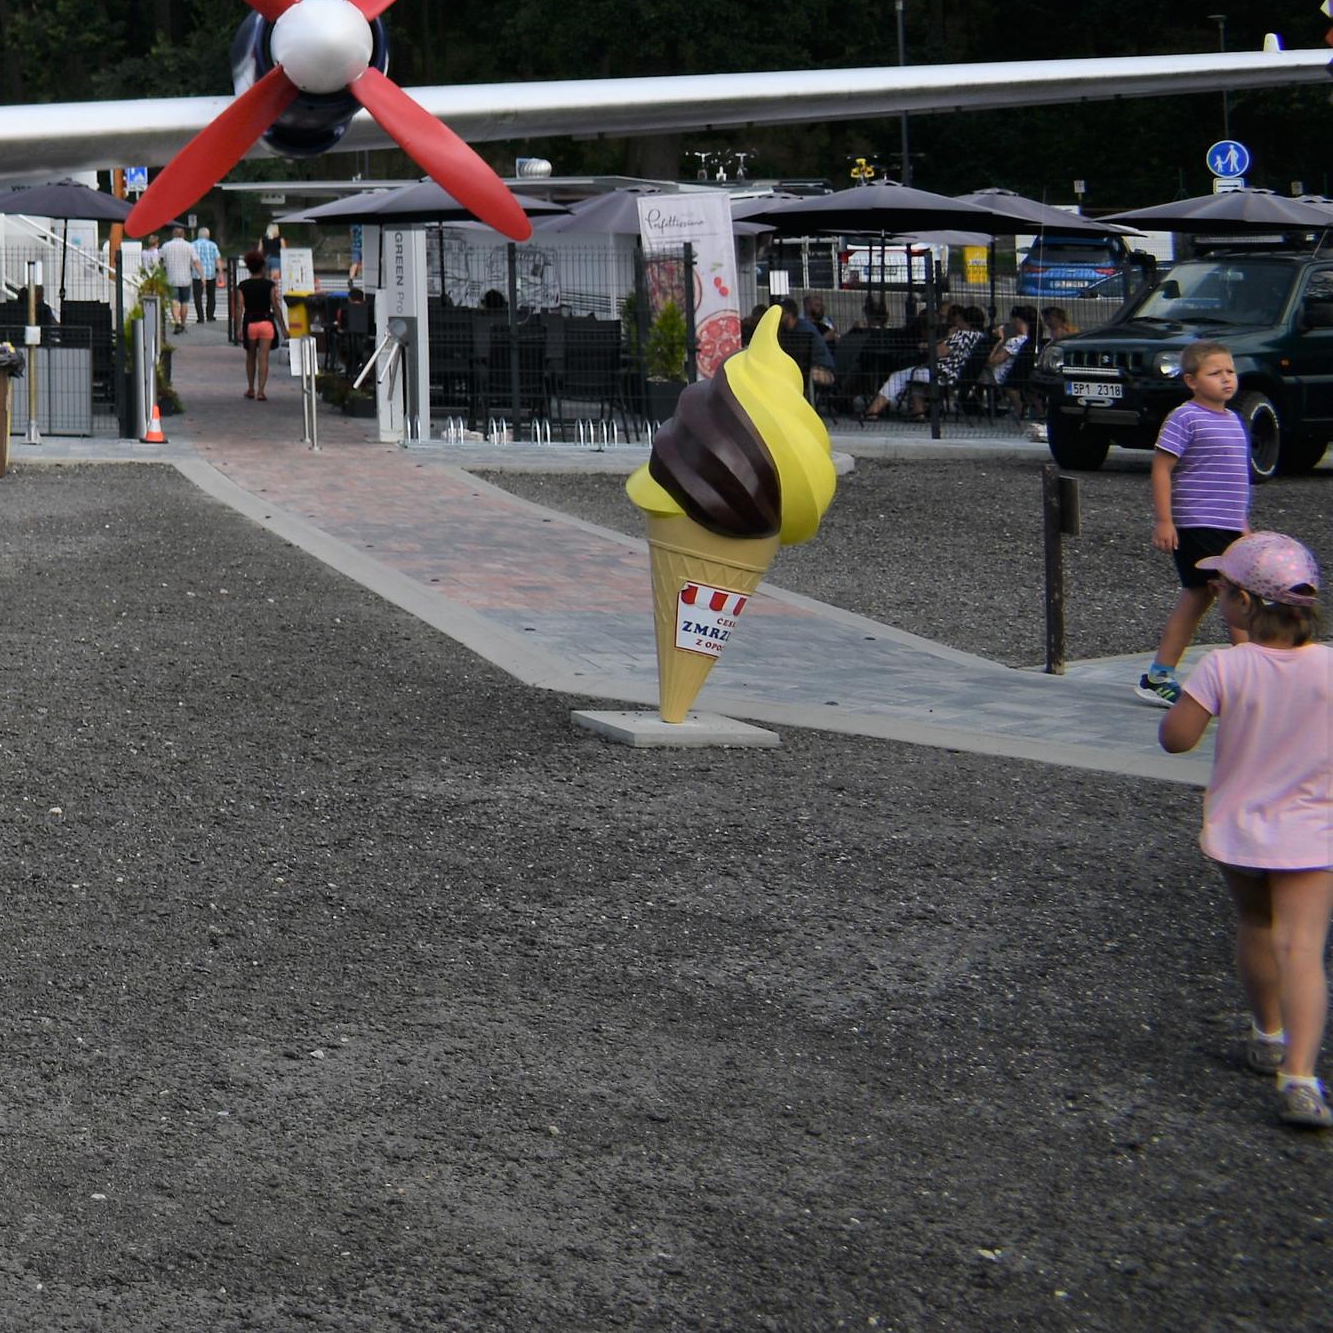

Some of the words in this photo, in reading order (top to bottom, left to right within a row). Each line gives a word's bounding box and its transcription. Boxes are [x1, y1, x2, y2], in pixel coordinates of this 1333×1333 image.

[395, 231, 404, 286] GREEN
[397, 292, 405, 314] Pro
[1073, 383, 1090, 395] 5P1
[1097, 384, 1121, 397] 2318
